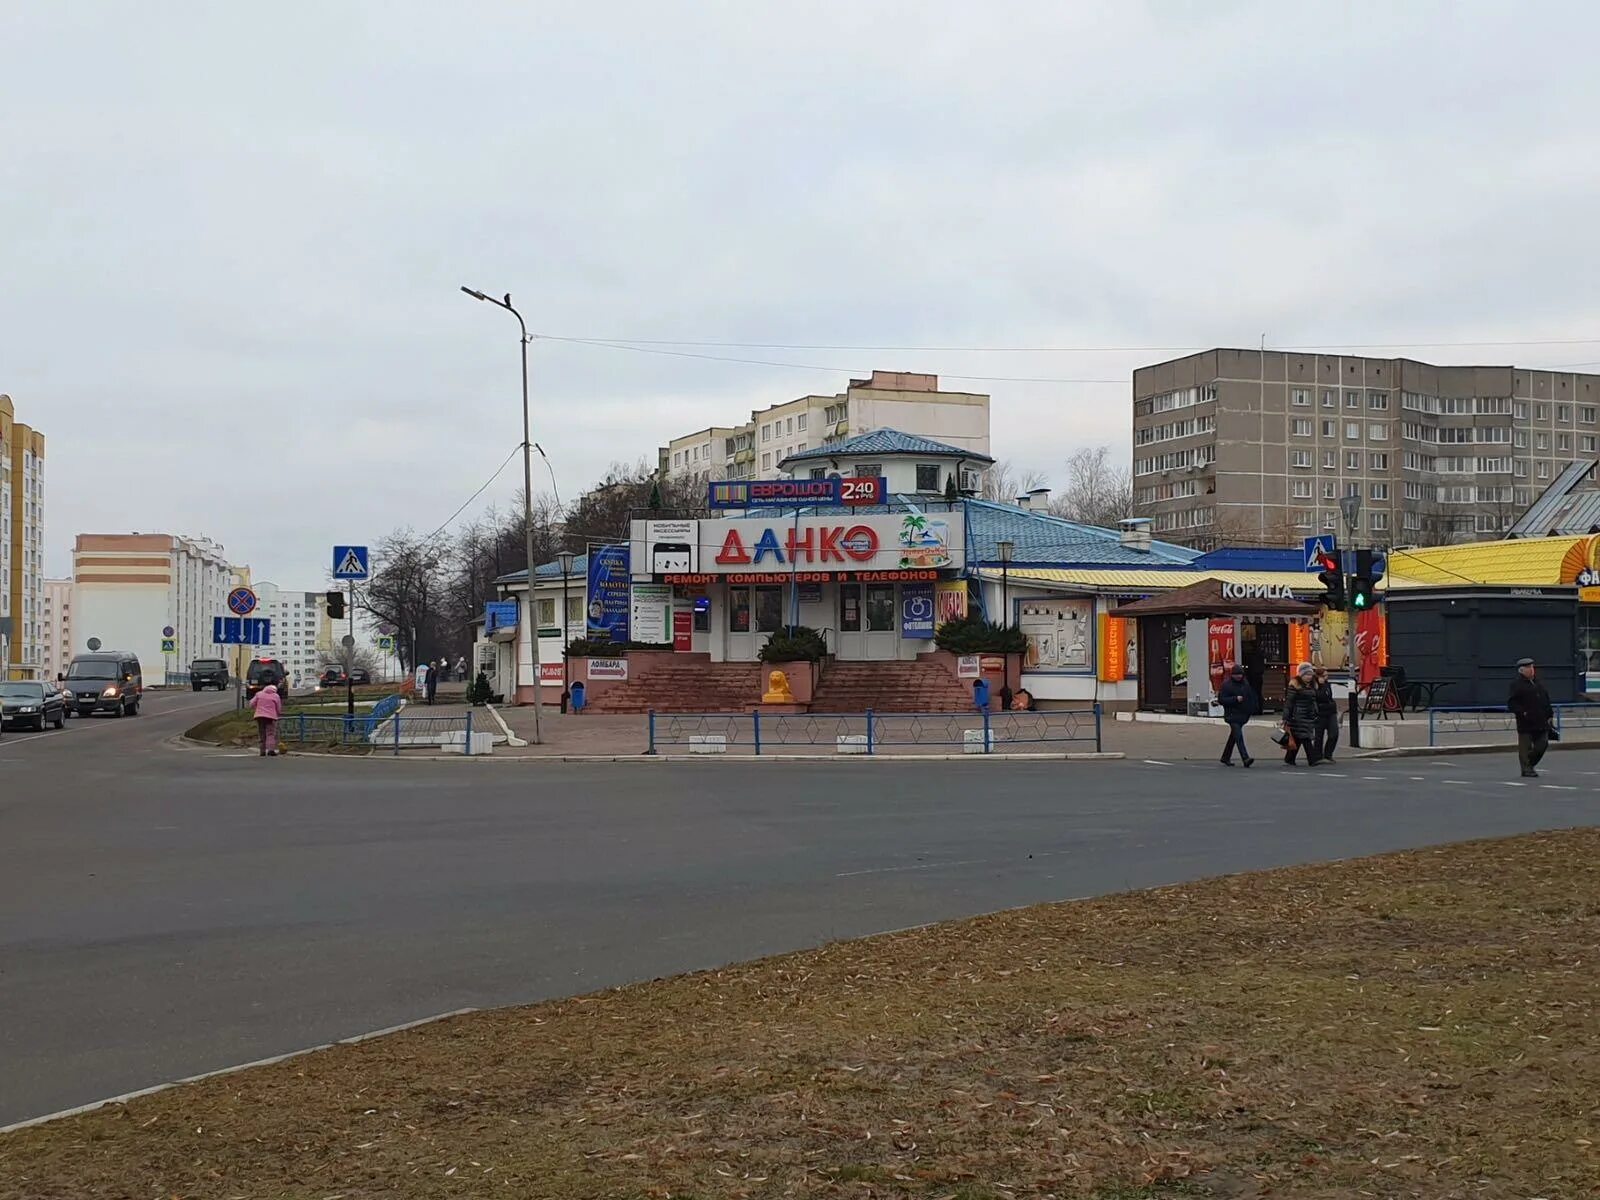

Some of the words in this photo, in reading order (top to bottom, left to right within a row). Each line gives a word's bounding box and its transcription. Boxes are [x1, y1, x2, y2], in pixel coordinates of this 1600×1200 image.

[752, 482, 833, 496] ЕВРОШОП
[715, 525, 879, 564] ДАНКО
[664, 574, 719, 584] РЕМОНТ
[726, 572, 830, 583] КОМПЬЮТЕРОВ
[838, 573, 847, 581] И
[855, 570, 937, 581] ТЕЛЕФОНОВ
[1222, 583, 1294, 599] КОРИЦА
